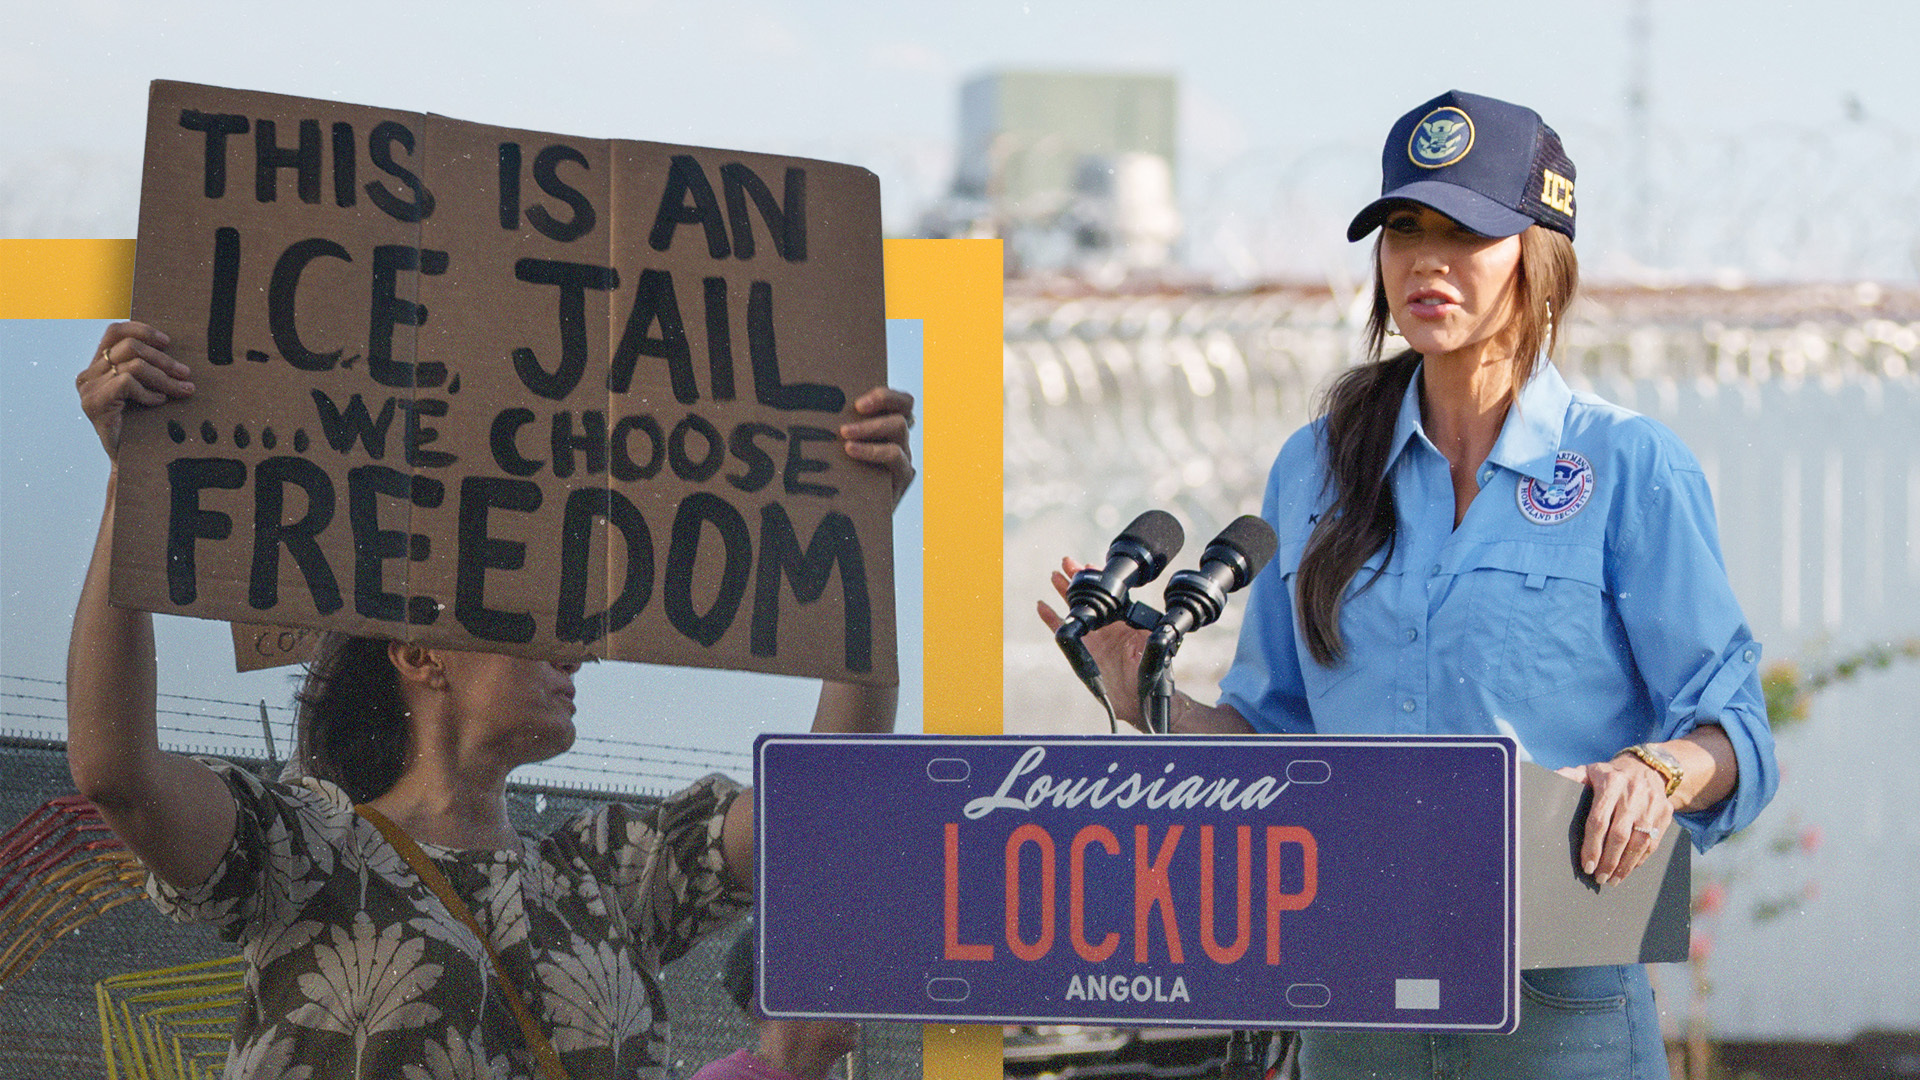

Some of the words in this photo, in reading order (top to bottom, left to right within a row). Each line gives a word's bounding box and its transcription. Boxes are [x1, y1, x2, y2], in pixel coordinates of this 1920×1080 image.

[179, 109, 436, 222] THIS
[499, 142, 596, 242] IS
[648, 155, 807, 262] AN
[1541, 169, 1575, 217] ICE
[512, 258, 846, 412] JAIL
[490, 408, 840, 497] CHOOSE
[1556, 452, 1590, 471] ARTMENT
[1520, 487, 1551, 521] HOMELAND
[1555, 489, 1590, 520] SECURITY
[166, 456, 873, 673] FREEDOM
